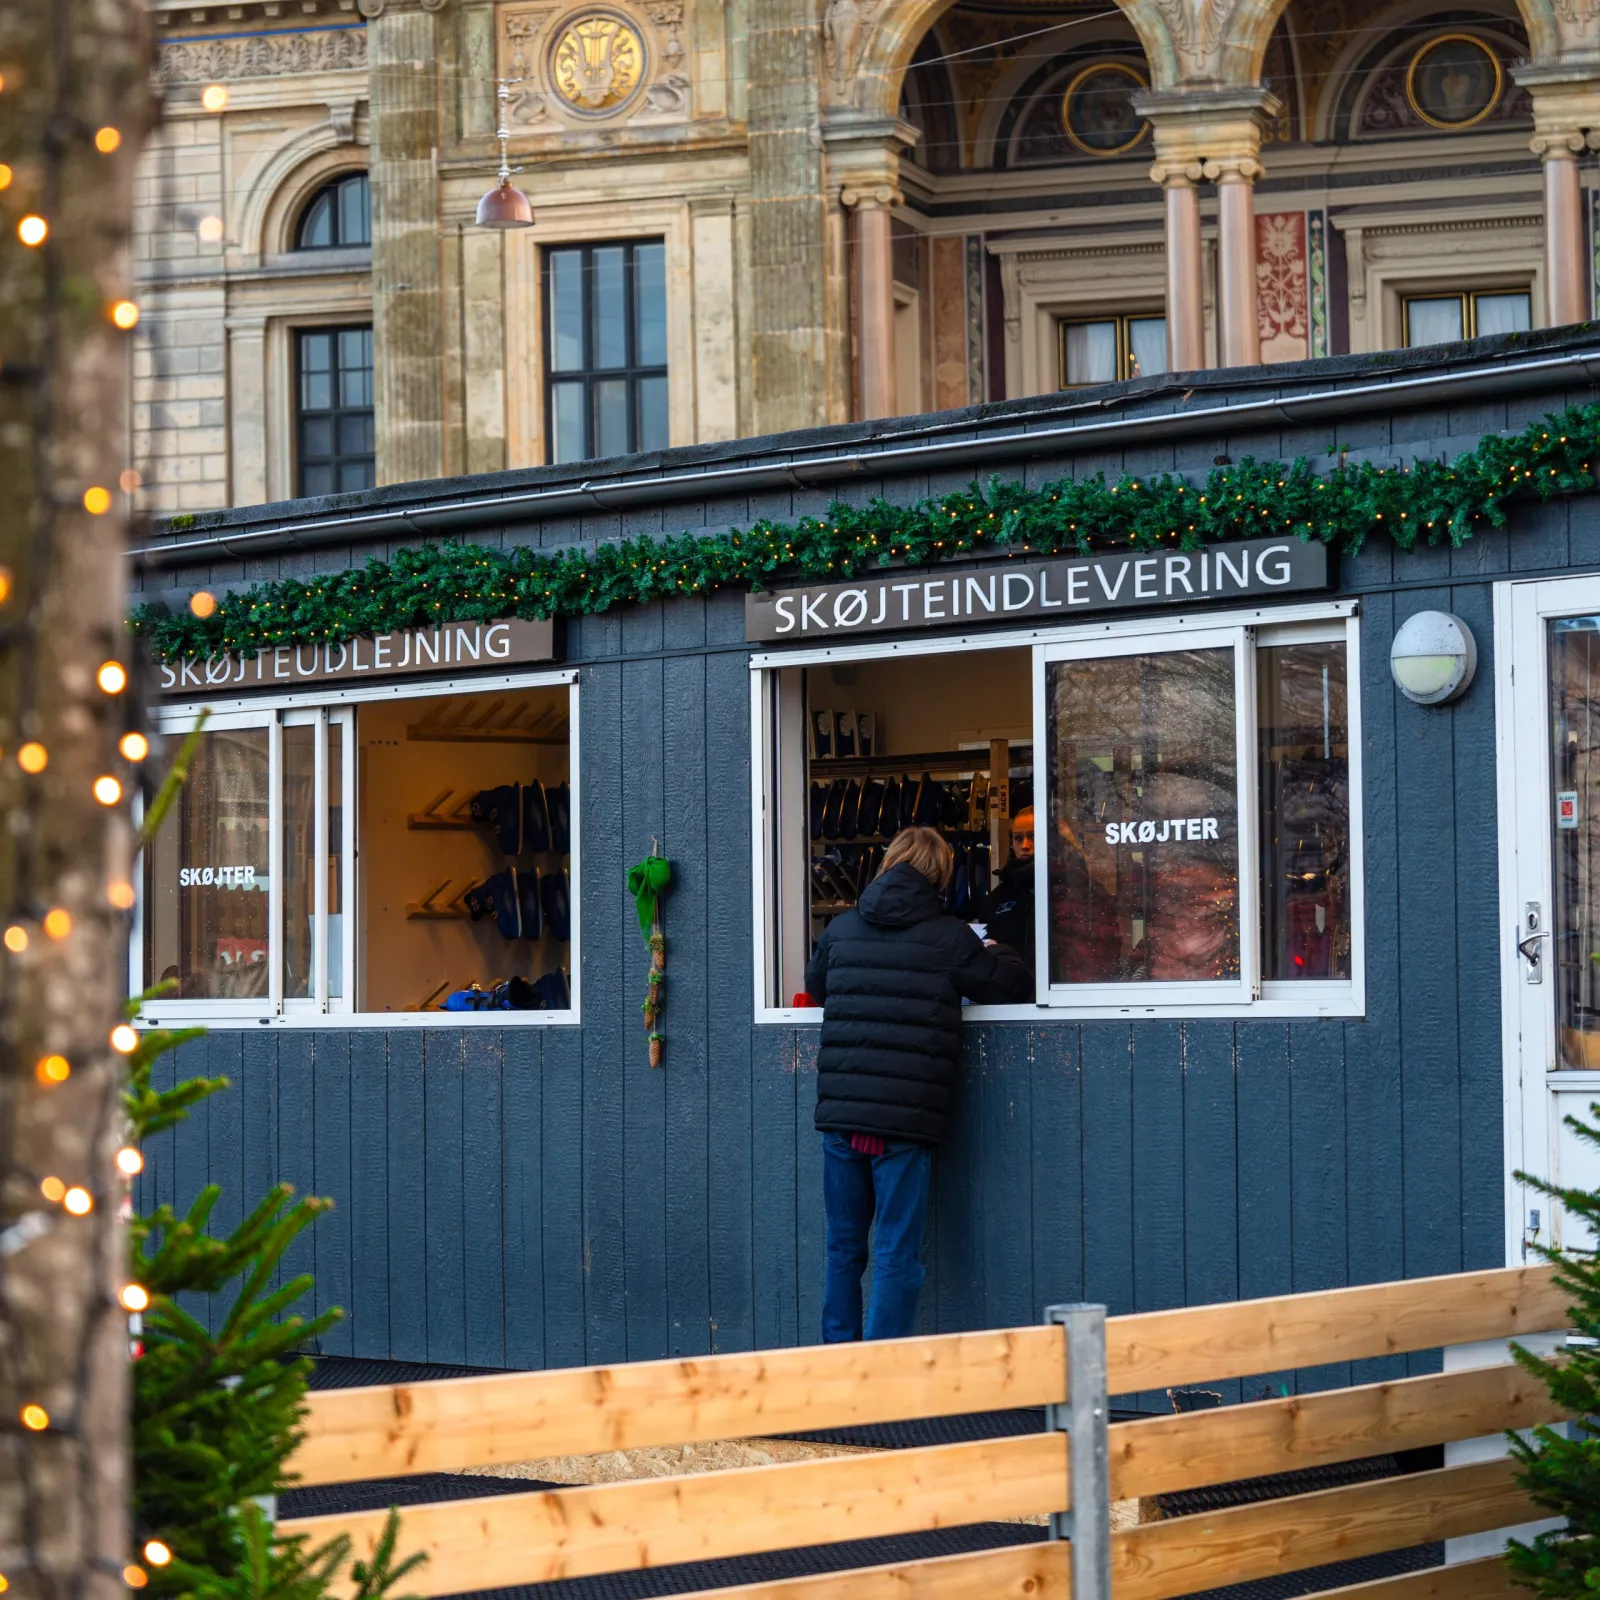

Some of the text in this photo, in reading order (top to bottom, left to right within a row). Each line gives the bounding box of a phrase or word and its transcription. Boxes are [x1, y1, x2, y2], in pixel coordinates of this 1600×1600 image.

[775, 545, 1291, 633] SKØJTEINDLEVERING
[160, 624, 511, 688] SKØJTEUDLEJNING
[1105, 817, 1219, 845] SKØJTER
[179, 865, 256, 887] SKØJTER
